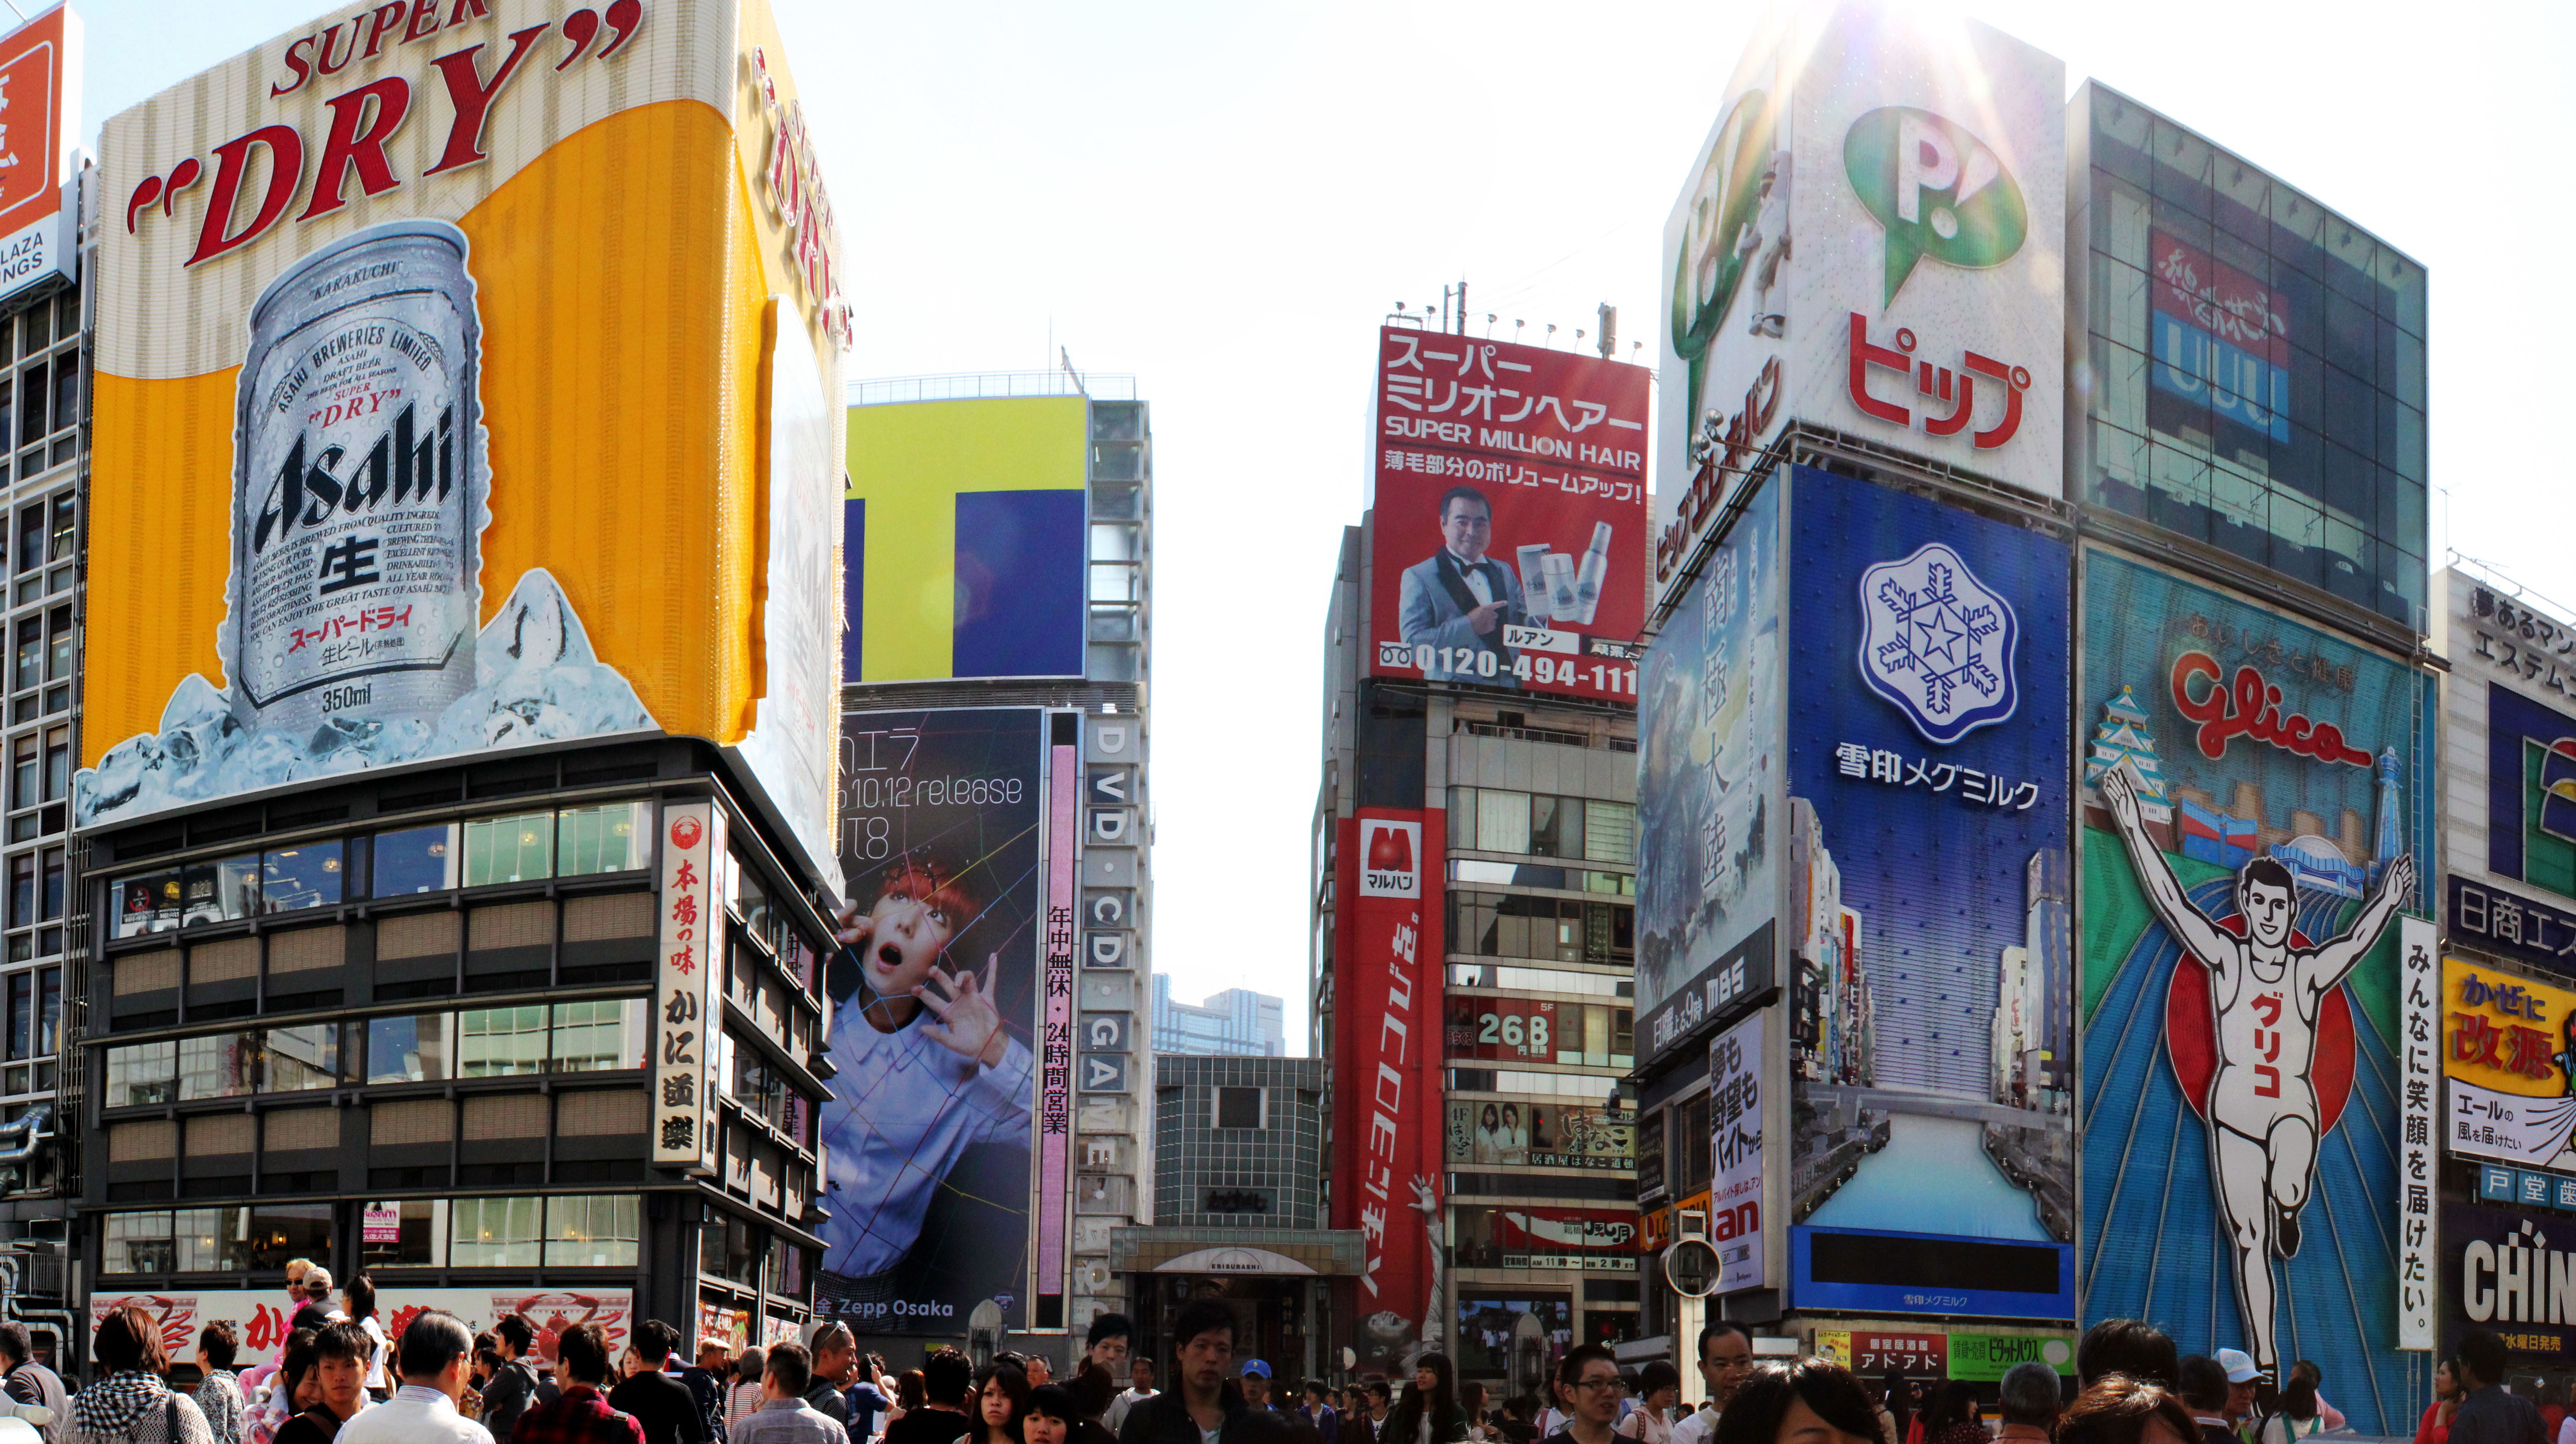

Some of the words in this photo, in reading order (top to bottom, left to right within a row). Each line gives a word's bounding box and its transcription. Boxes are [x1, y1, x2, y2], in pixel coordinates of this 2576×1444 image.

[278, 367, 309, 413] ASAHI
[312, 327, 385, 369] BREWERIES
[390, 330, 432, 371] LIMITED
[323, 364, 354, 383] DRAFT
[356, 357, 381, 372] BEER
[337, 349, 367, 366] ASAHI
[1387, 334, 1531, 381] スーパー
[334, 382, 371, 401] SUPER
[1848, 311, 2031, 449] ピップ
[1387, 374, 1642, 434] ミリオンヘアー
[1385, 416, 1471, 445] SUPER
[1480, 428, 1572, 460] MILLION
[1580, 444, 1640, 471] HAIR
[254, 399, 454, 556] Asahi
[299, 526, 336, 546] BREWED
[338, 520, 364, 533] FROM
[367, 512, 405, 526] QUALITY
[386, 523, 432, 533] CULTURED
[387, 534, 419, 547] BREWING
[318, 536, 380, 596] 生
[387, 548, 425, 559] EXCELLENT
[294, 570, 313, 583] HAS
[386, 574, 404, 583] ALL
[406, 572, 428, 581] YEAR
[279, 609, 303, 626] ENJOY
[306, 601, 325, 616] THE
[326, 592, 359, 608] GREAT
[361, 587, 391, 599] TASTE
[393, 586, 404, 595] OF
[289, 605, 412, 653] スーパードライ
[1508, 629, 1554, 646] ルアン
[2191, 612, 2353, 691] おいしさと健康
[322, 683, 372, 713] 350ml
[2171, 650, 2373, 767] Glico
[916, 775, 1022, 806] release
[1836, 742, 2039, 810] 雪印メグミルク
[1367, 874, 1414, 892] マルハン
[670, 859, 699, 975] 本場の味
[1541, 1003, 1554, 1011] 5F
[2462, 973, 2546, 1022] かぜに
[1654, 991, 1703, 1052] 日曜よる9時
[2250, 991, 2284, 1099] グリコ
[2451, 1011, 2555, 1080] 改源
[1711, 1036, 1741, 1091] 夢も
[1449, 1108, 1469, 1121] 4F
[1711, 1070, 1757, 1136] 野望も
[2458, 1094, 2513, 1121] エールの
[1712, 1122, 1761, 1180] バイトから
[2403, 944, 2431, 1328] みんなに笑顔を届けたい。
[2457, 1121, 2522, 1150] 風を届けたい
[1532, 1153, 1634, 1169] 居酒屋はなこ道頓
[1584, 1220, 1631, 1244] 風月
[1716, 1200, 1759, 1242] an
[816, 1298, 832, 1314] 金
[839, 1299, 887, 1318] Zepp
[893, 1300, 953, 1316] Osaka
[1903, 1294, 1967, 1308] 雪印メグミルク
[1862, 1353, 1937, 1370] アドアド
[1870, 1338, 1928, 1351] 個室居酒屋
